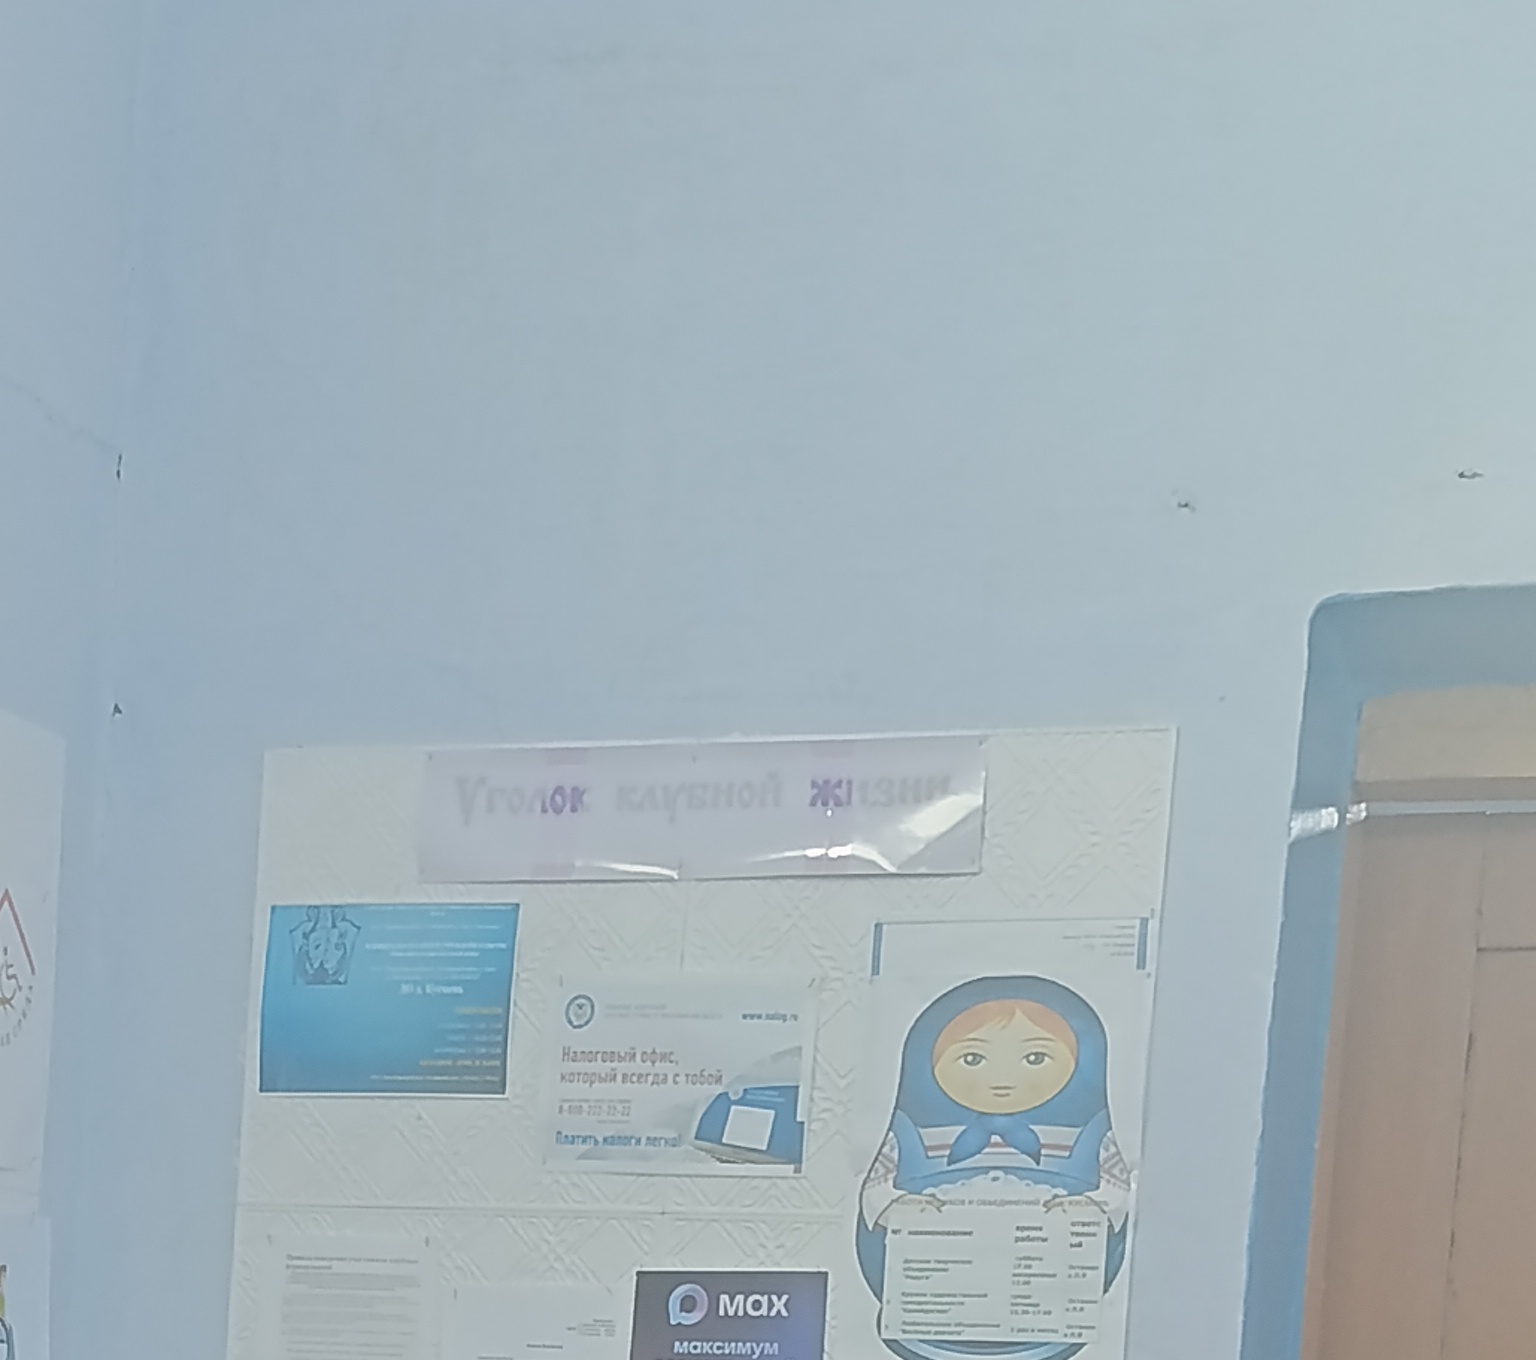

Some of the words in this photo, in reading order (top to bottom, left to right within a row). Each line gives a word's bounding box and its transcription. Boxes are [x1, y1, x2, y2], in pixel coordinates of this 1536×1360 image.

[453, 774, 589, 828] Уголок
[561, 1046, 637, 1065] Налоговый
[640, 1047, 679, 1067] офис,
[560, 1067, 618, 1088] который
[621, 1072, 668, 1087] всегда
[672, 1073, 680, 1085] с
[684, 1069, 723, 1086] тобой
[555, 1131, 599, 1147] Платить
[602, 1134, 641, 1147] налоги
[673, 1341, 779, 1360] максимум
